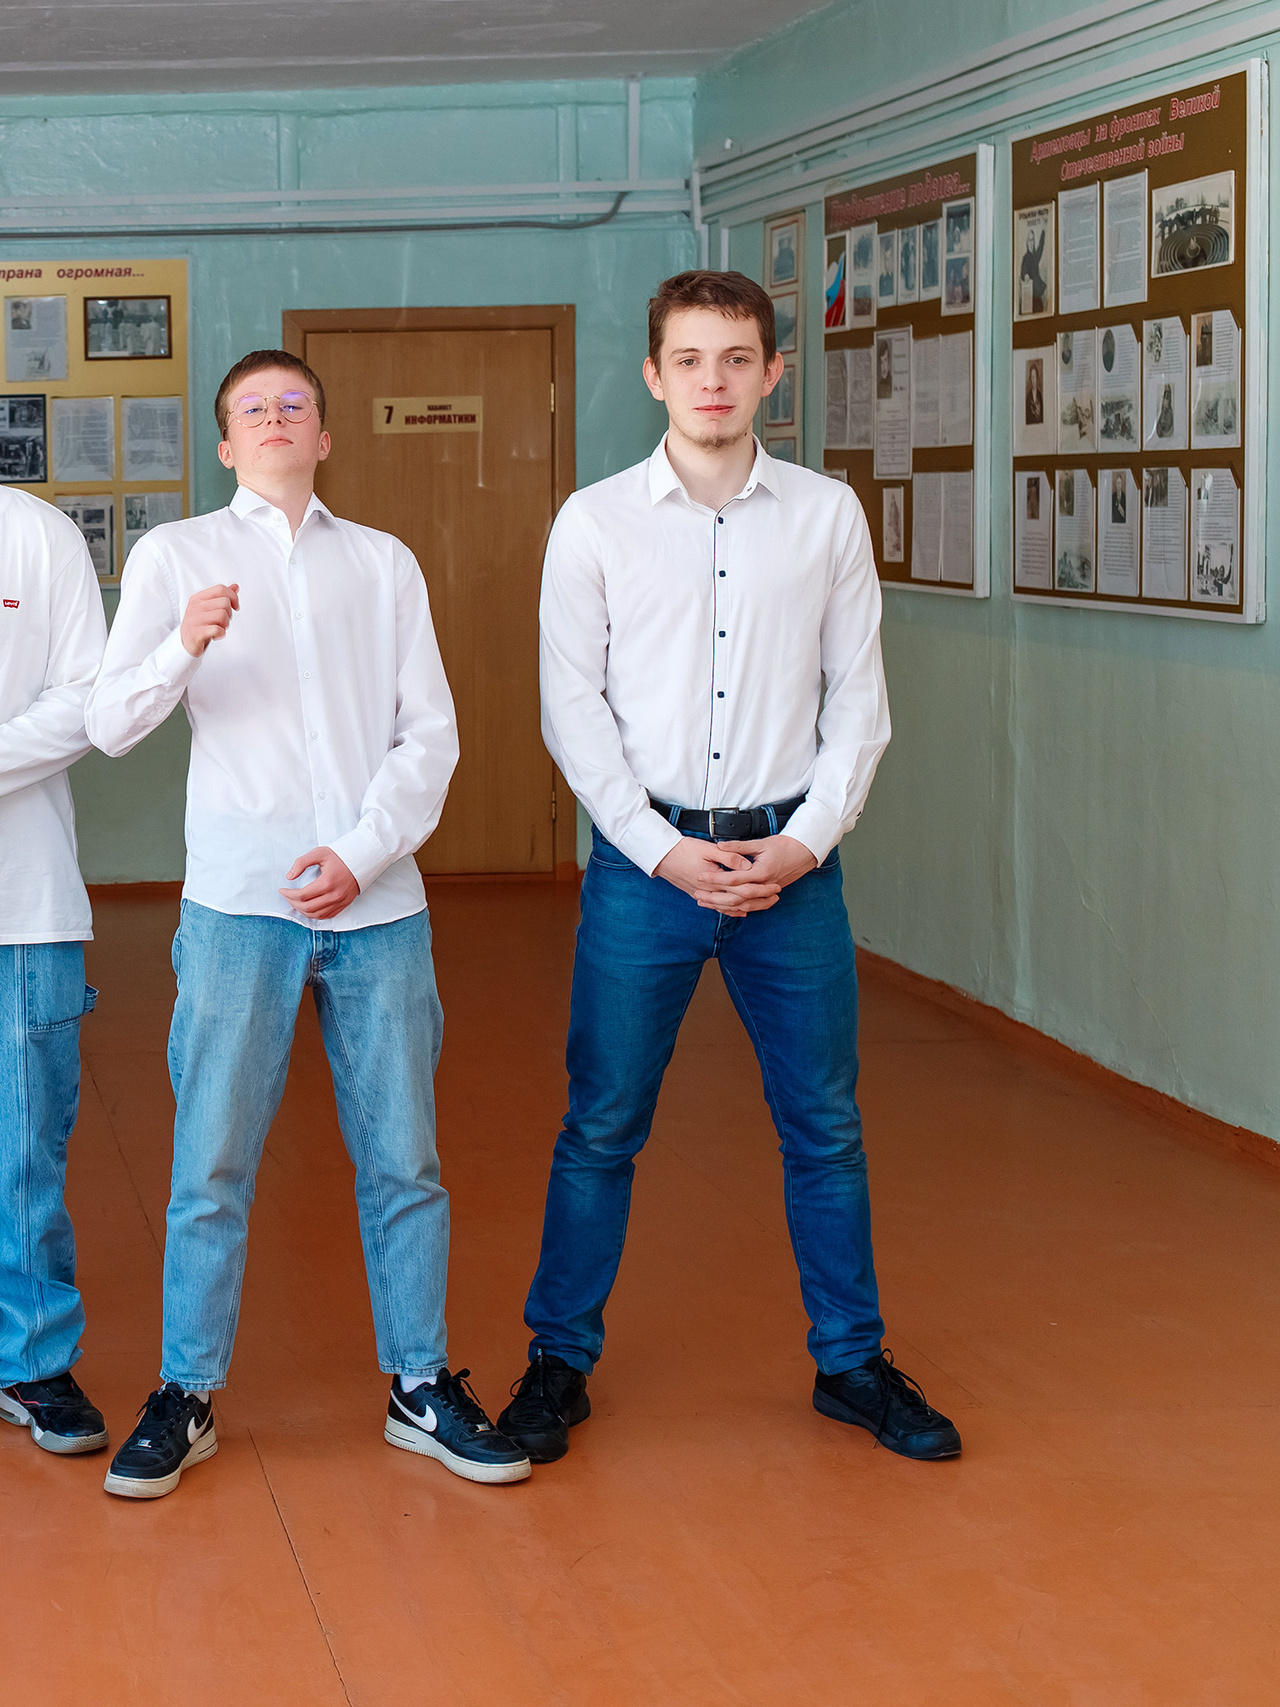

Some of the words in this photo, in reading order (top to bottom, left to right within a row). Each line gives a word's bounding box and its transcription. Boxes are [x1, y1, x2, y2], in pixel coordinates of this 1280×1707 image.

[1094, 124, 1107, 142] на
[1109, 107, 1161, 142] фронтах
[1169, 84, 1220, 121] Великой
[1060, 137, 1145, 181] Отечественной
[1147, 131, 1185, 158] войны
[56, 266, 145, 281] огромная...
[384, 405, 394, 424] 7
[405, 414, 476, 425] ИНФОРМАТИКИ
